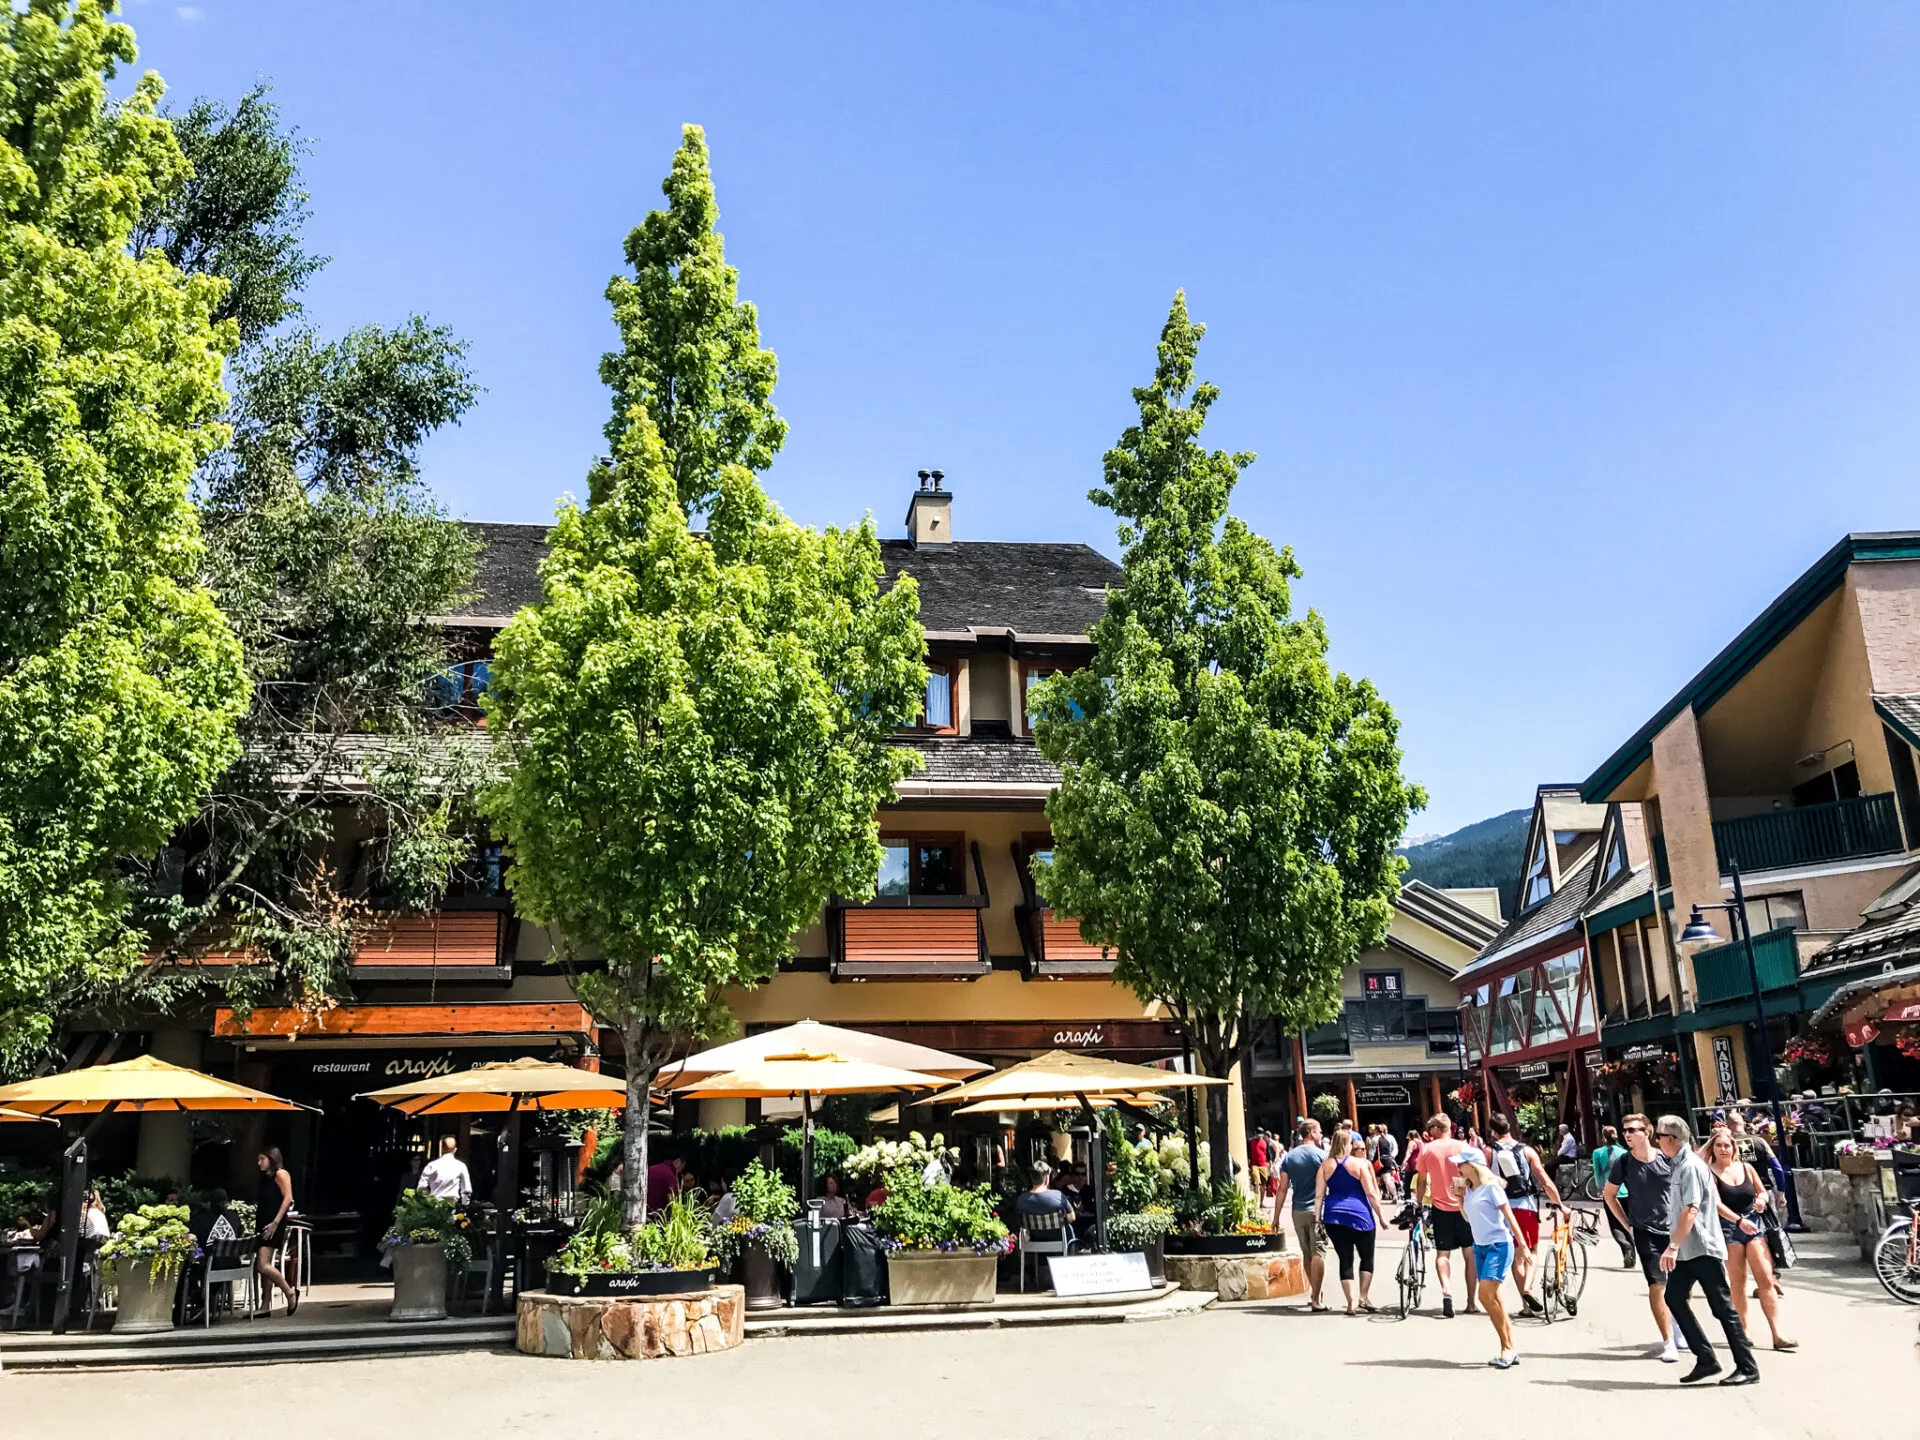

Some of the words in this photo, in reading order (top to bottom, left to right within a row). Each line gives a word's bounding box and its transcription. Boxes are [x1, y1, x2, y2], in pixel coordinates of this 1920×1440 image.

[1053, 1024, 1104, 1047] araxi
[312, 1062, 370, 1073] restaurant
[385, 1050, 456, 1078] araxi
[609, 1275, 640, 1290] araxi
